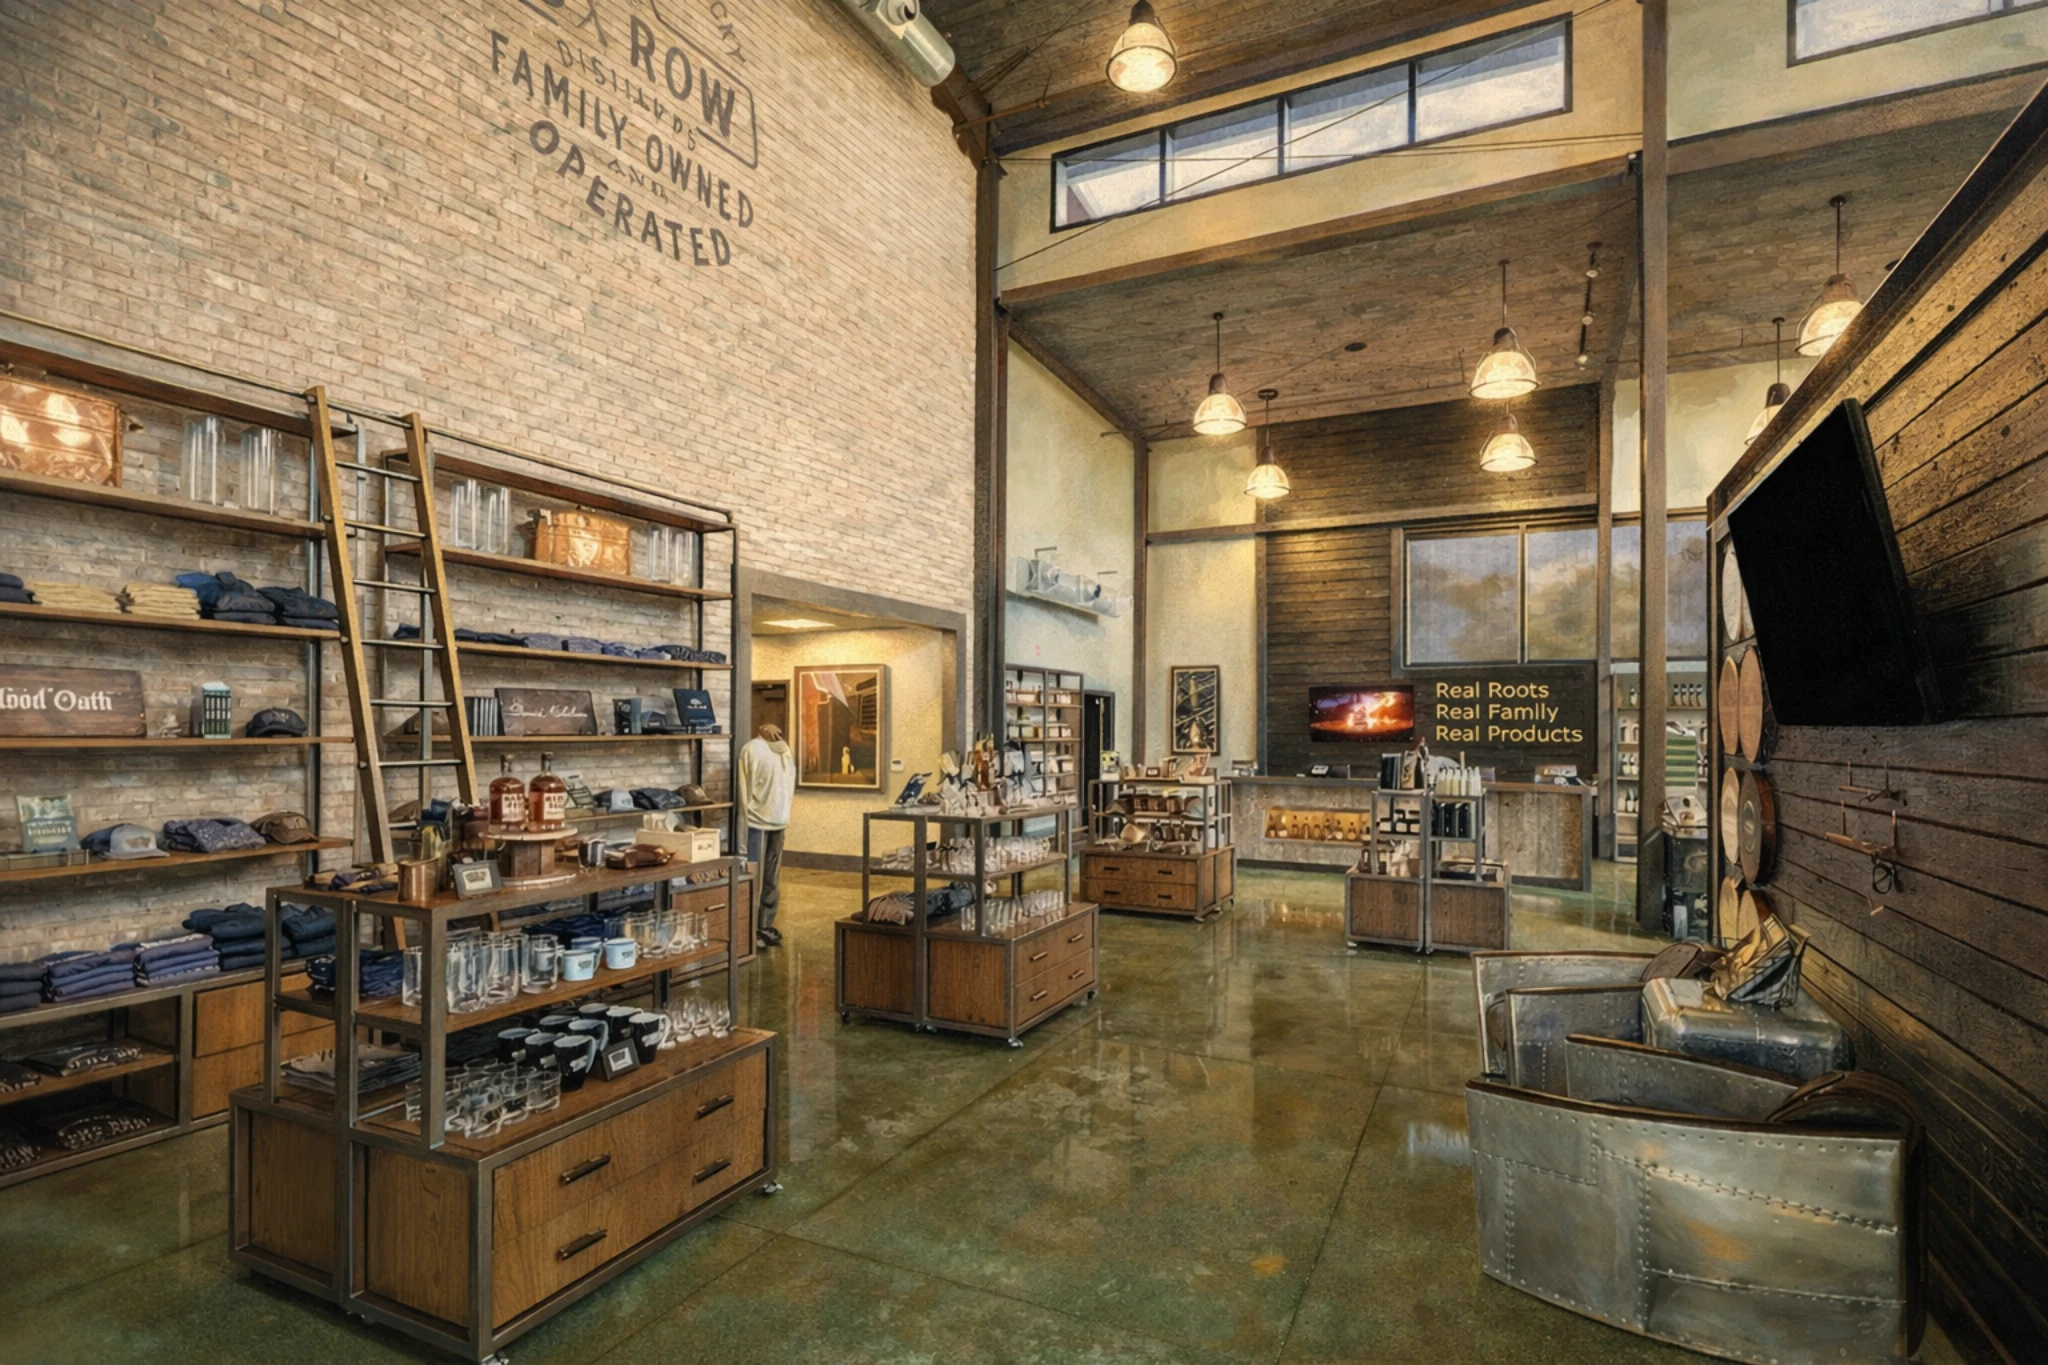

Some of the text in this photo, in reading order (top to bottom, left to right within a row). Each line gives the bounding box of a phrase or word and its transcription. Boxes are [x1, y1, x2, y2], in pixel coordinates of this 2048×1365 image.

[629, 13, 736, 138] ROW
[490, 29, 754, 228] FAMILY OWNED
[528, 119, 732, 267] OPERATED
[1435, 681, 1550, 699] Real Roots
[1435, 703, 1480, 721] Real
[1435, 724, 1584, 743] Real Products
